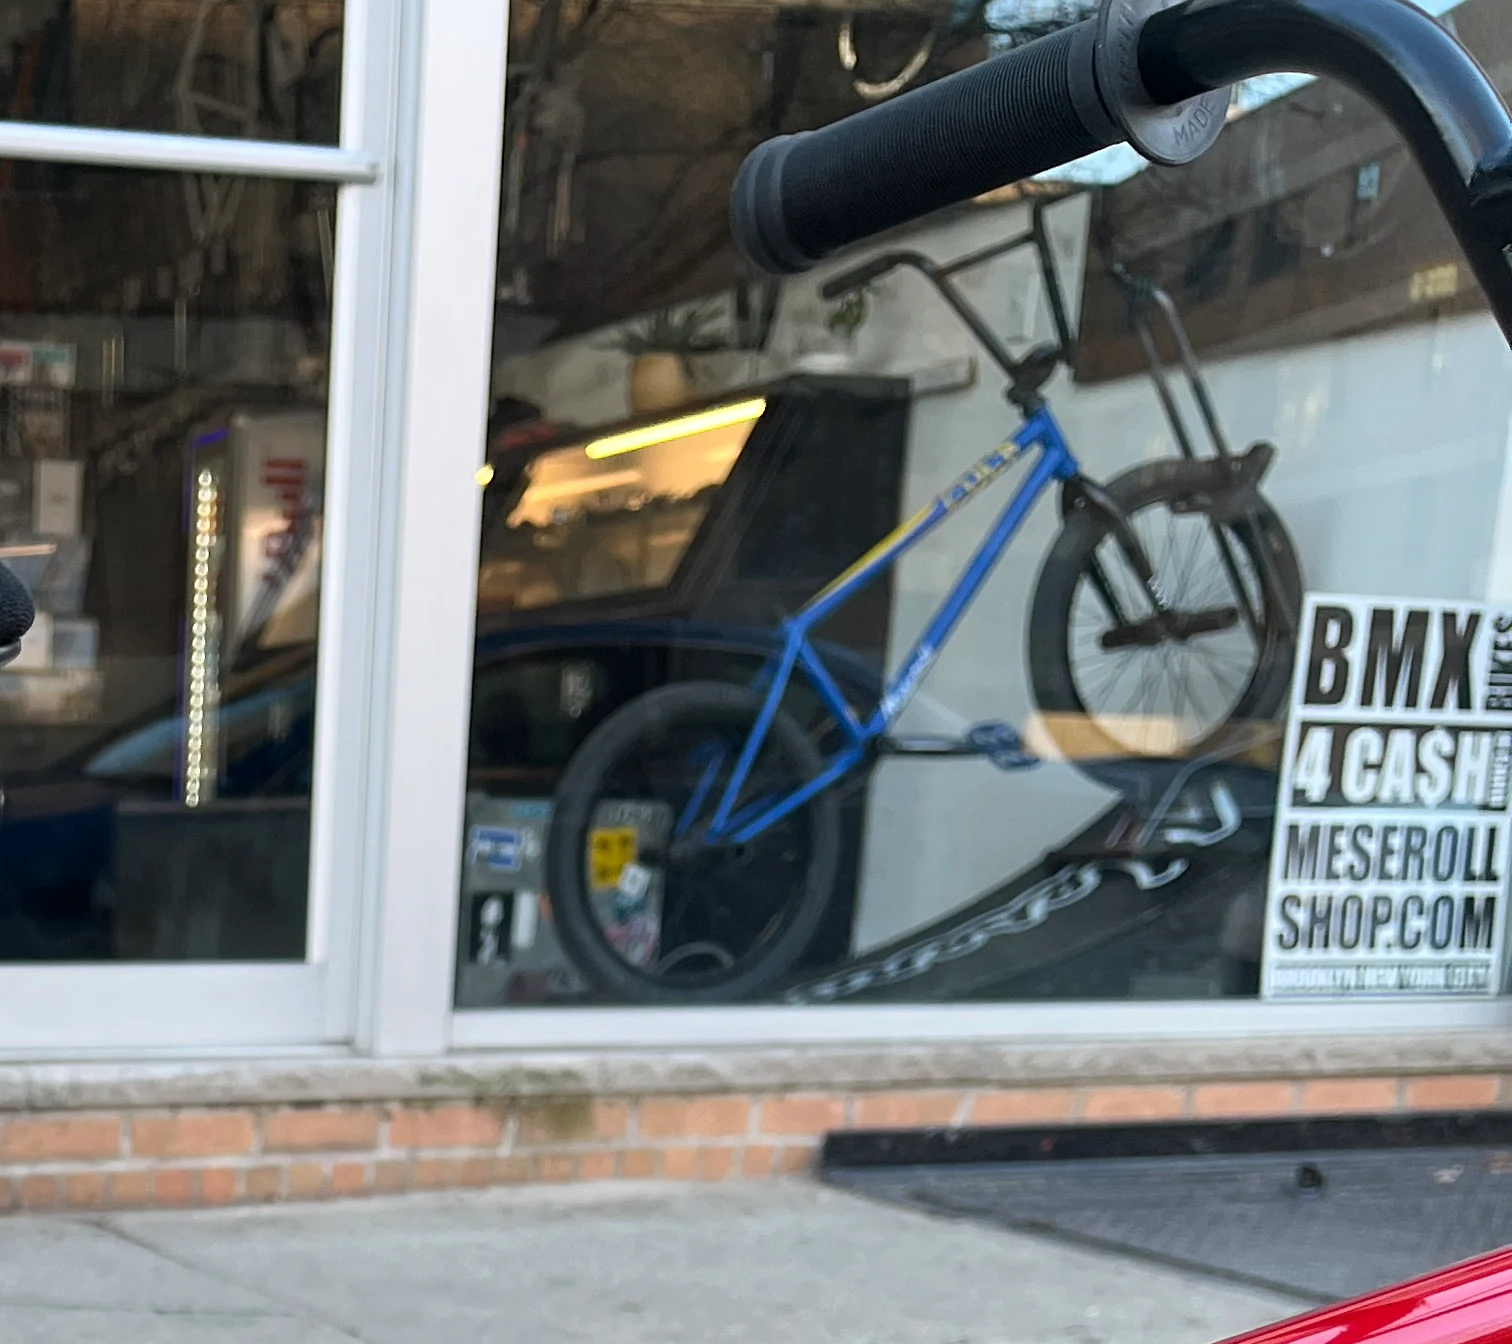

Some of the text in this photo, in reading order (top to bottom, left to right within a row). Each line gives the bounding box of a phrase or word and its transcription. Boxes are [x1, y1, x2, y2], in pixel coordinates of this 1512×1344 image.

[1302, 605, 1482, 711] BMX
[1295, 726, 1333, 804] 4
[1284, 824, 1501, 883] MESEROLL
[1276, 893, 1498, 951] SHOP.COM
